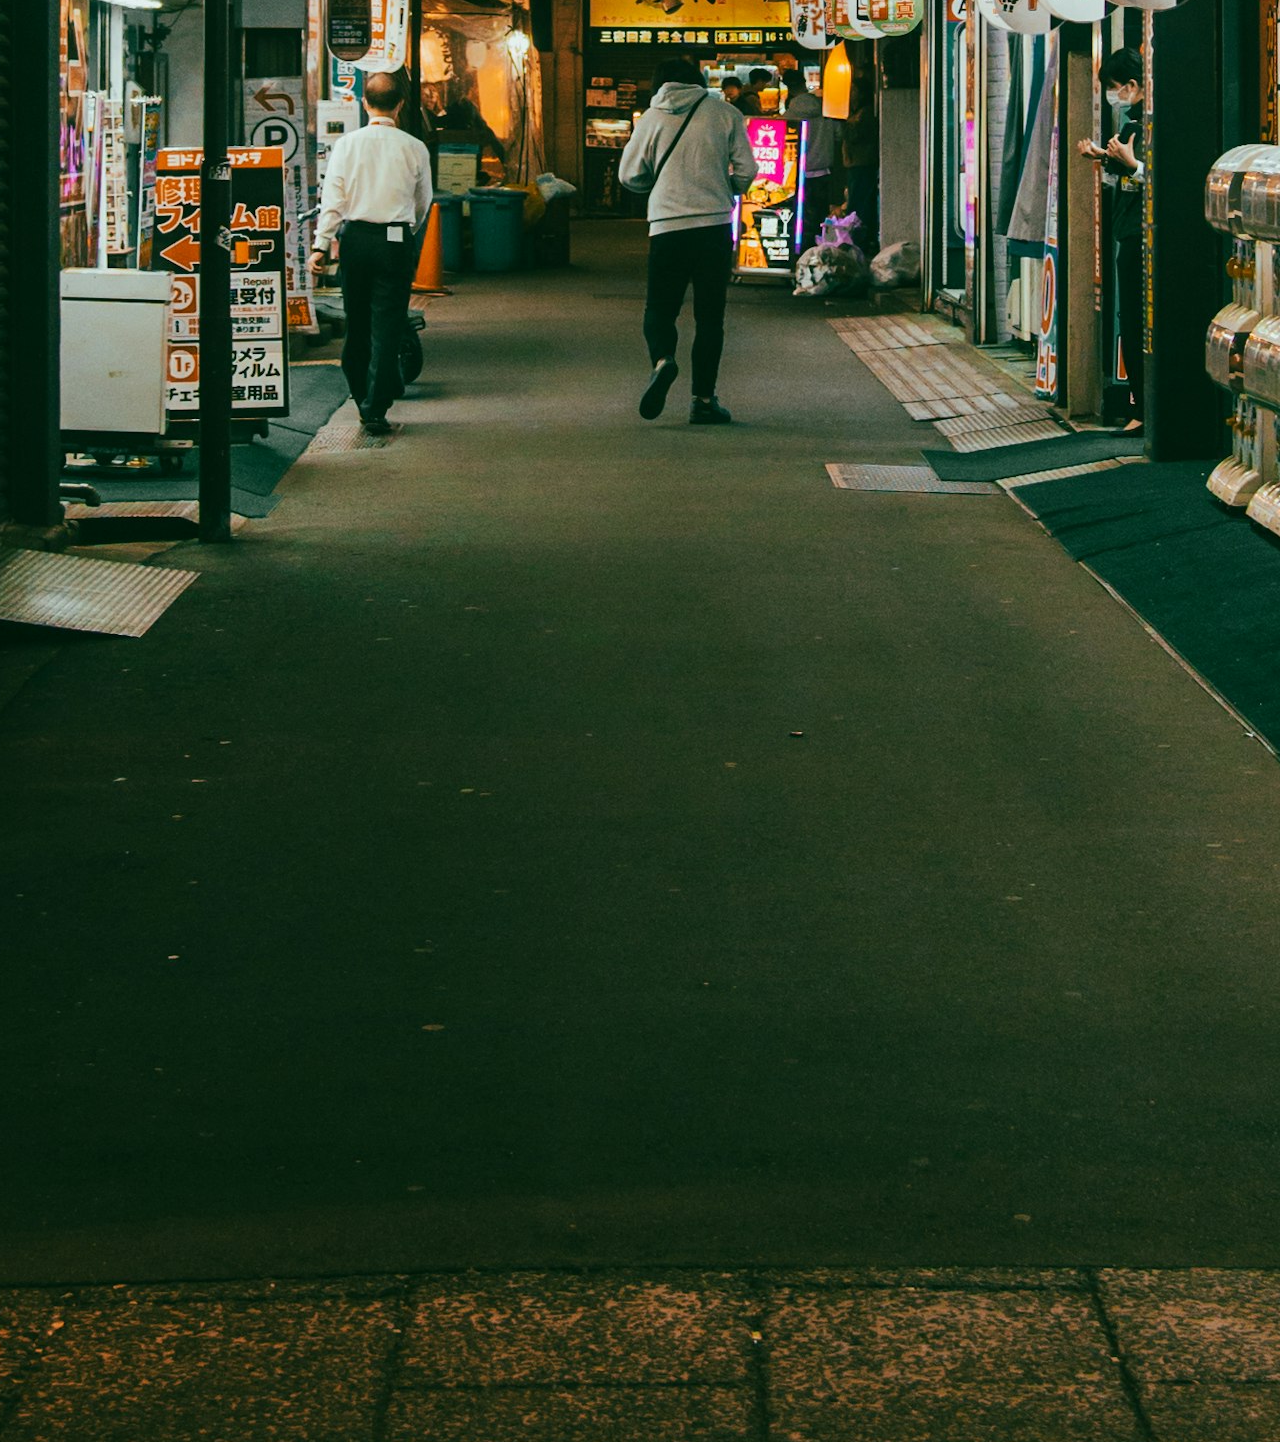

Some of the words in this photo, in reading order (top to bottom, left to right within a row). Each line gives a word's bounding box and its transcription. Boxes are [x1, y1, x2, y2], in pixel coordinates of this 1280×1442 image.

[599, 30, 653, 44] 三密回避
[656, 30, 710, 44] 完全個室
[242, 277, 275, 287] Repair
[172, 287, 191, 304] 2F
[174, 356, 191, 372] 1F
